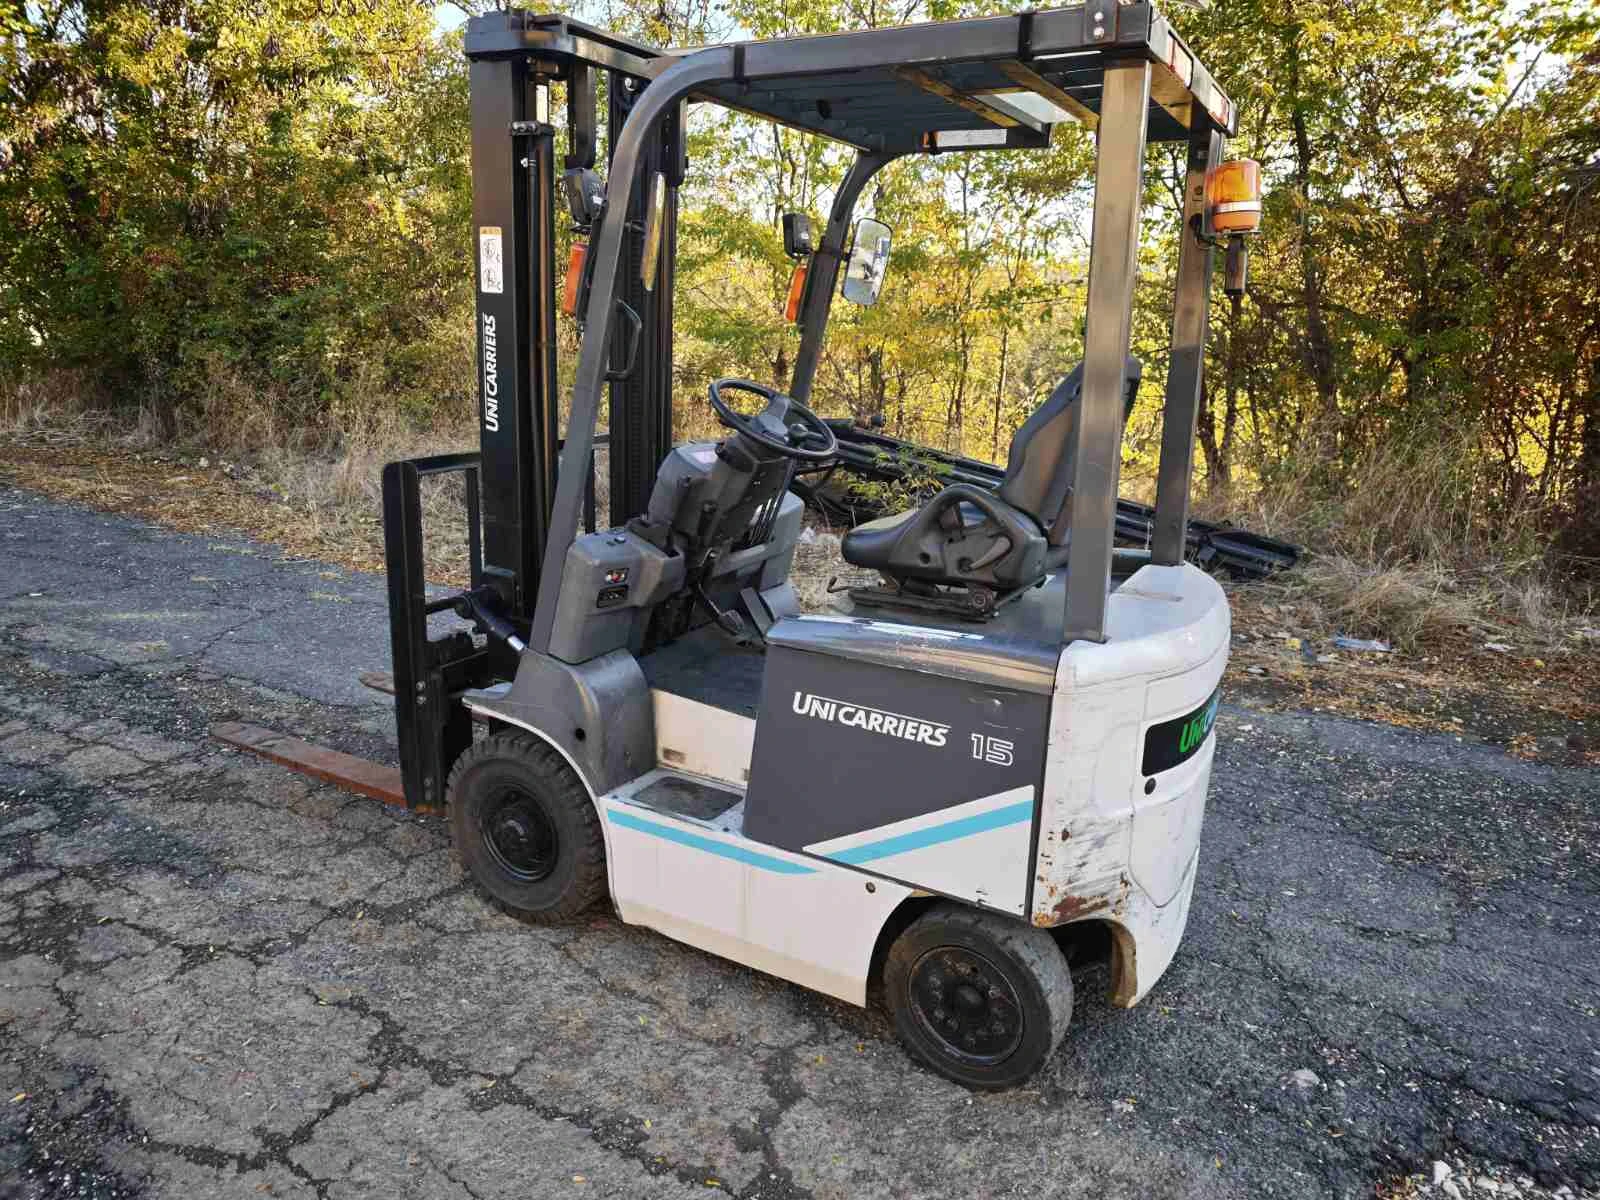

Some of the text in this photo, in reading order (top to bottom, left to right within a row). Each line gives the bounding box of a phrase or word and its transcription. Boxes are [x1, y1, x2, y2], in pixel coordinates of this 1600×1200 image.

[483, 313, 499, 432] UNICARRIERS
[793, 692, 951, 747] UNICARRIERS
[971, 733, 1013, 766] 15
